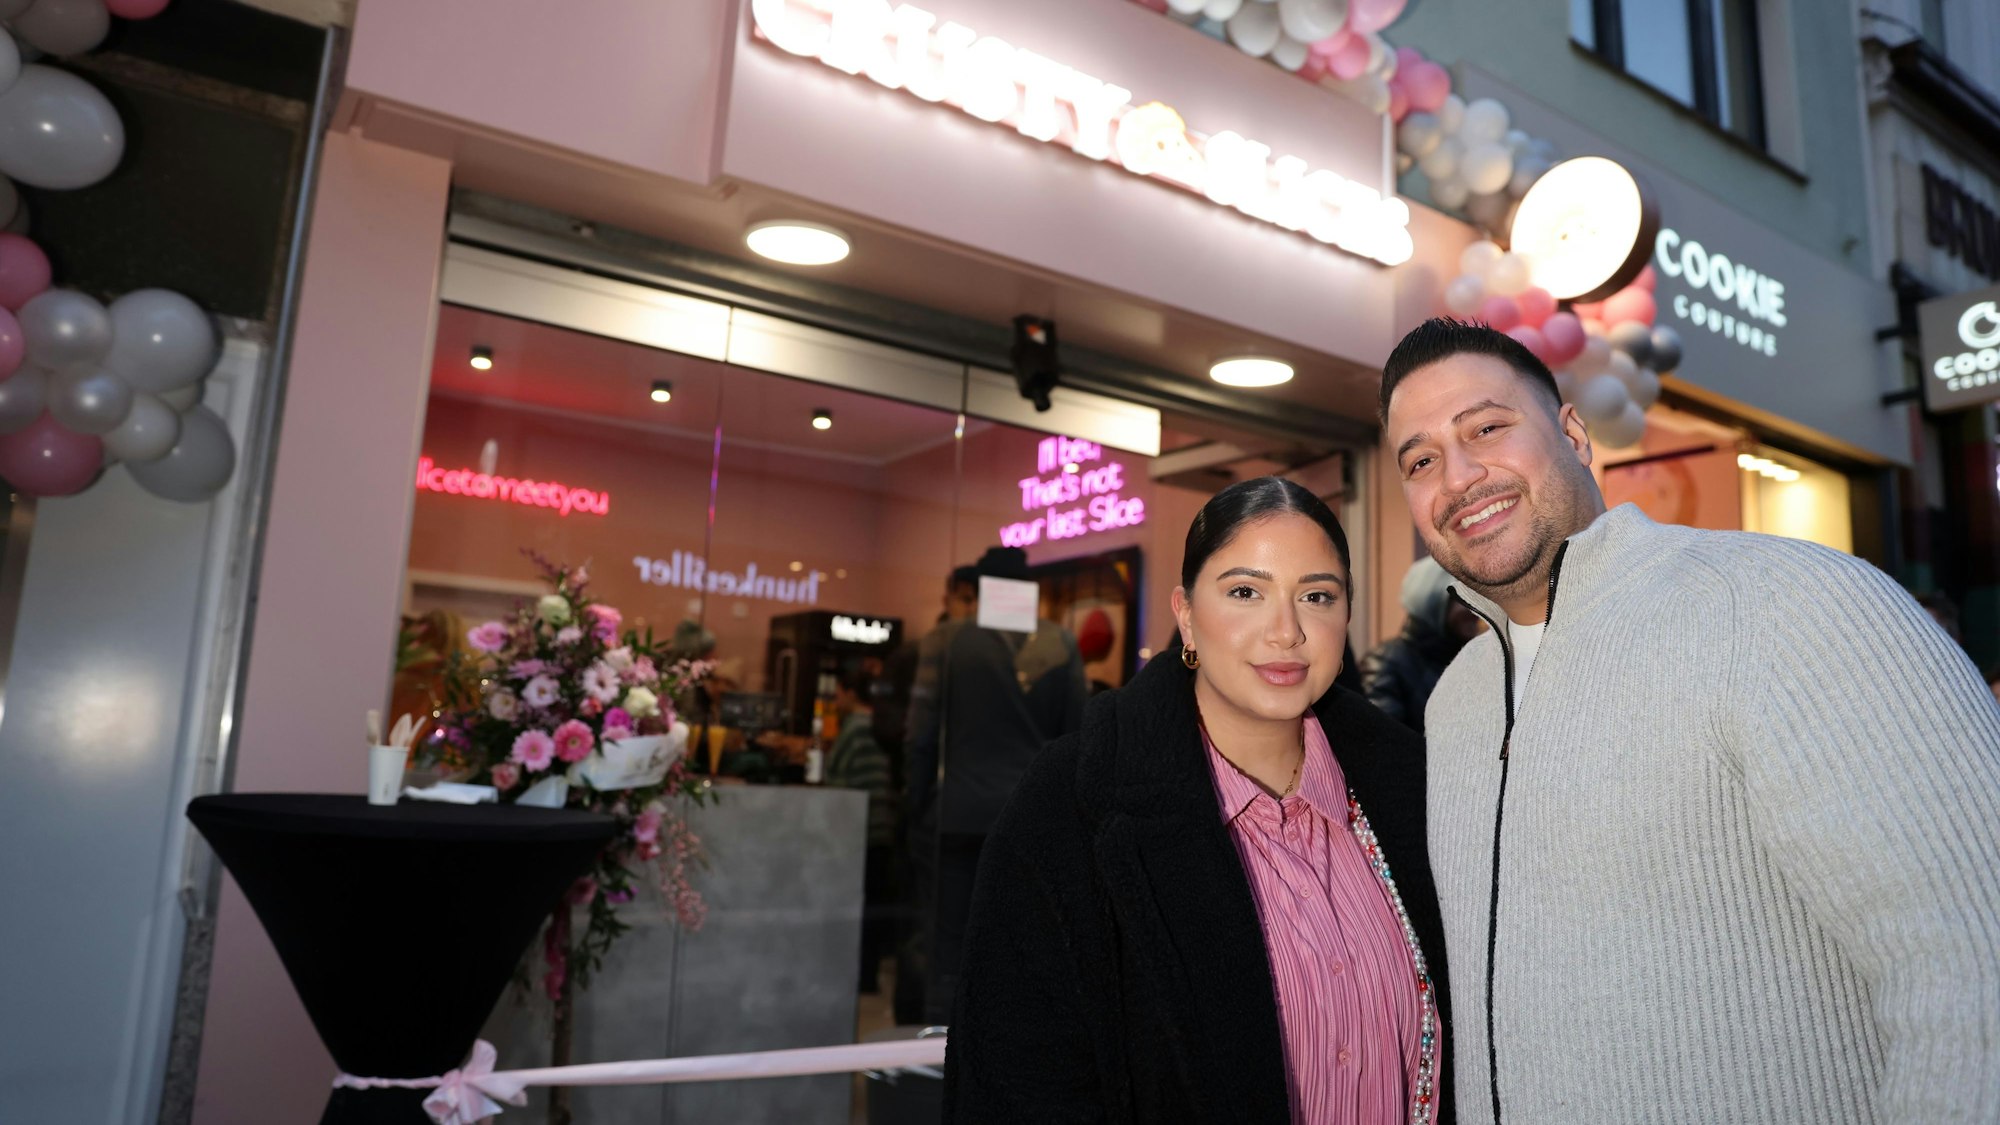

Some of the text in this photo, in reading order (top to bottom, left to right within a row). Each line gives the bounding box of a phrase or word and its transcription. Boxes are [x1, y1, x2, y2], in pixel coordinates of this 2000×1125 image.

[1655, 227, 1788, 327] COOKIE
[1673, 294, 1777, 357] COUTURE
[1934, 345, 2000, 380] COO
[1947, 369, 2000, 392] COUT
[1081, 462, 1123, 496] not
[1047, 508, 1087, 540] last
[1089, 494, 1145, 531] Slice
